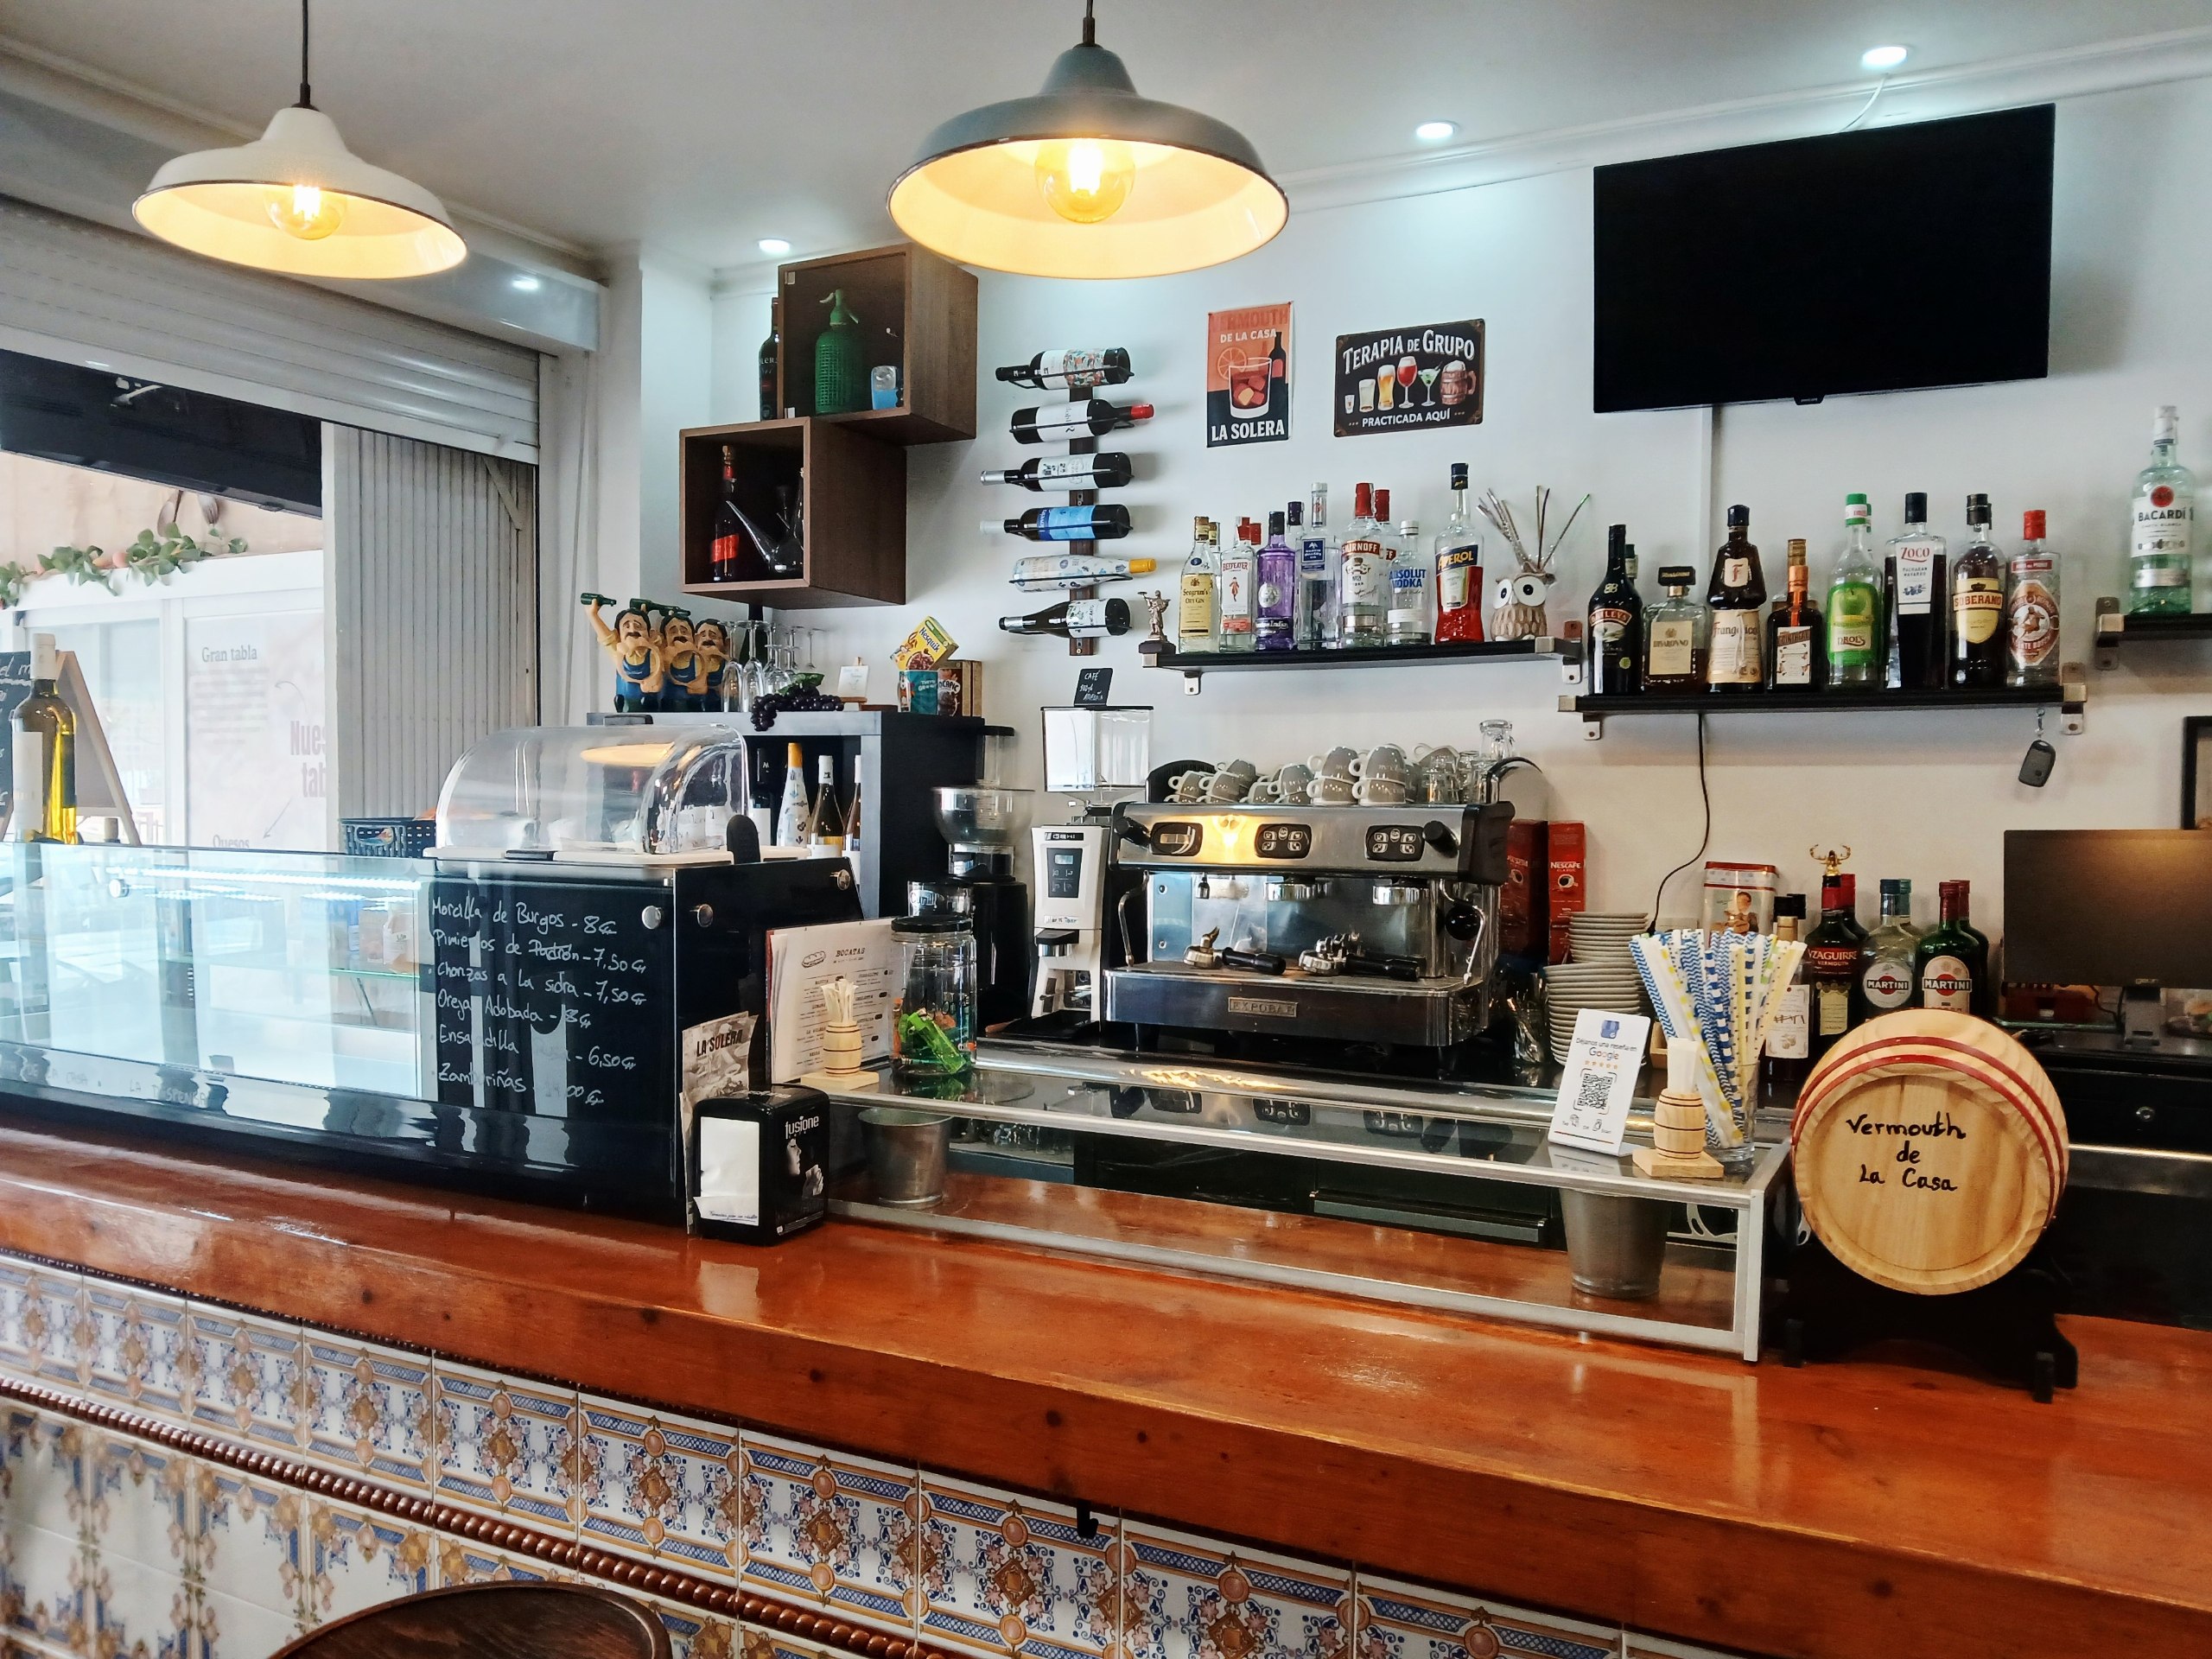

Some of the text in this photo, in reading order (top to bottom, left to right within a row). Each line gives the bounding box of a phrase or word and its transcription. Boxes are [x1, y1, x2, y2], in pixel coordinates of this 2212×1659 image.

[1220, 328, 1277, 344] DE LA CASA
[1343, 335, 1404, 375] TERAPIA
[1422, 329, 1476, 360] GRUPO
[1362, 408, 1451, 428] PRACTICADA AQUÍ
[1211, 419, 1286, 442] LA SOLERA
[2138, 506, 2186, 522] BACARDÍ
[1437, 551, 1474, 571] APEROL
[1900, 547, 1930, 561] ZOCO
[1223, 562, 1249, 571] BEEFEATER
[1389, 569, 1427, 581] ABSOLUT
[1392, 578, 1423, 589] VODKA
[1591, 610, 1627, 623] BLEYS
[919, 626, 941, 653] Nesquik
[1712, 621, 1758, 638] Frangico
[201, 645, 257, 663] Gran tabla
[432, 894, 483, 921] Morcilla
[493, 899, 508, 923] de
[516, 901, 564, 935] Burgos
[433, 929, 496, 951] Pimieos
[505, 932, 523, 955] de
[835, 947, 866, 957] BOCATAS
[498, 973, 508, 987] a
[544, 970, 580, 998] sidra
[1866, 980, 1909, 990] MARTINI
[1924, 978, 1971, 990] MARTINI
[438, 988, 472, 1021] Oreja
[485, 992, 543, 1022] Adobada
[439, 1023, 519, 1054] Ensadilla
[696, 1029, 744, 1057] LA SOLERA
[1588, 1046, 1619, 1061] Google
[438, 1062, 527, 1092] Zambriñas
[785, 1115, 820, 1140] fusione
[1846, 1111, 1967, 1141] Vermouth
[1896, 1141, 1922, 1164] de
[1902, 1167, 1958, 1192] Casa
